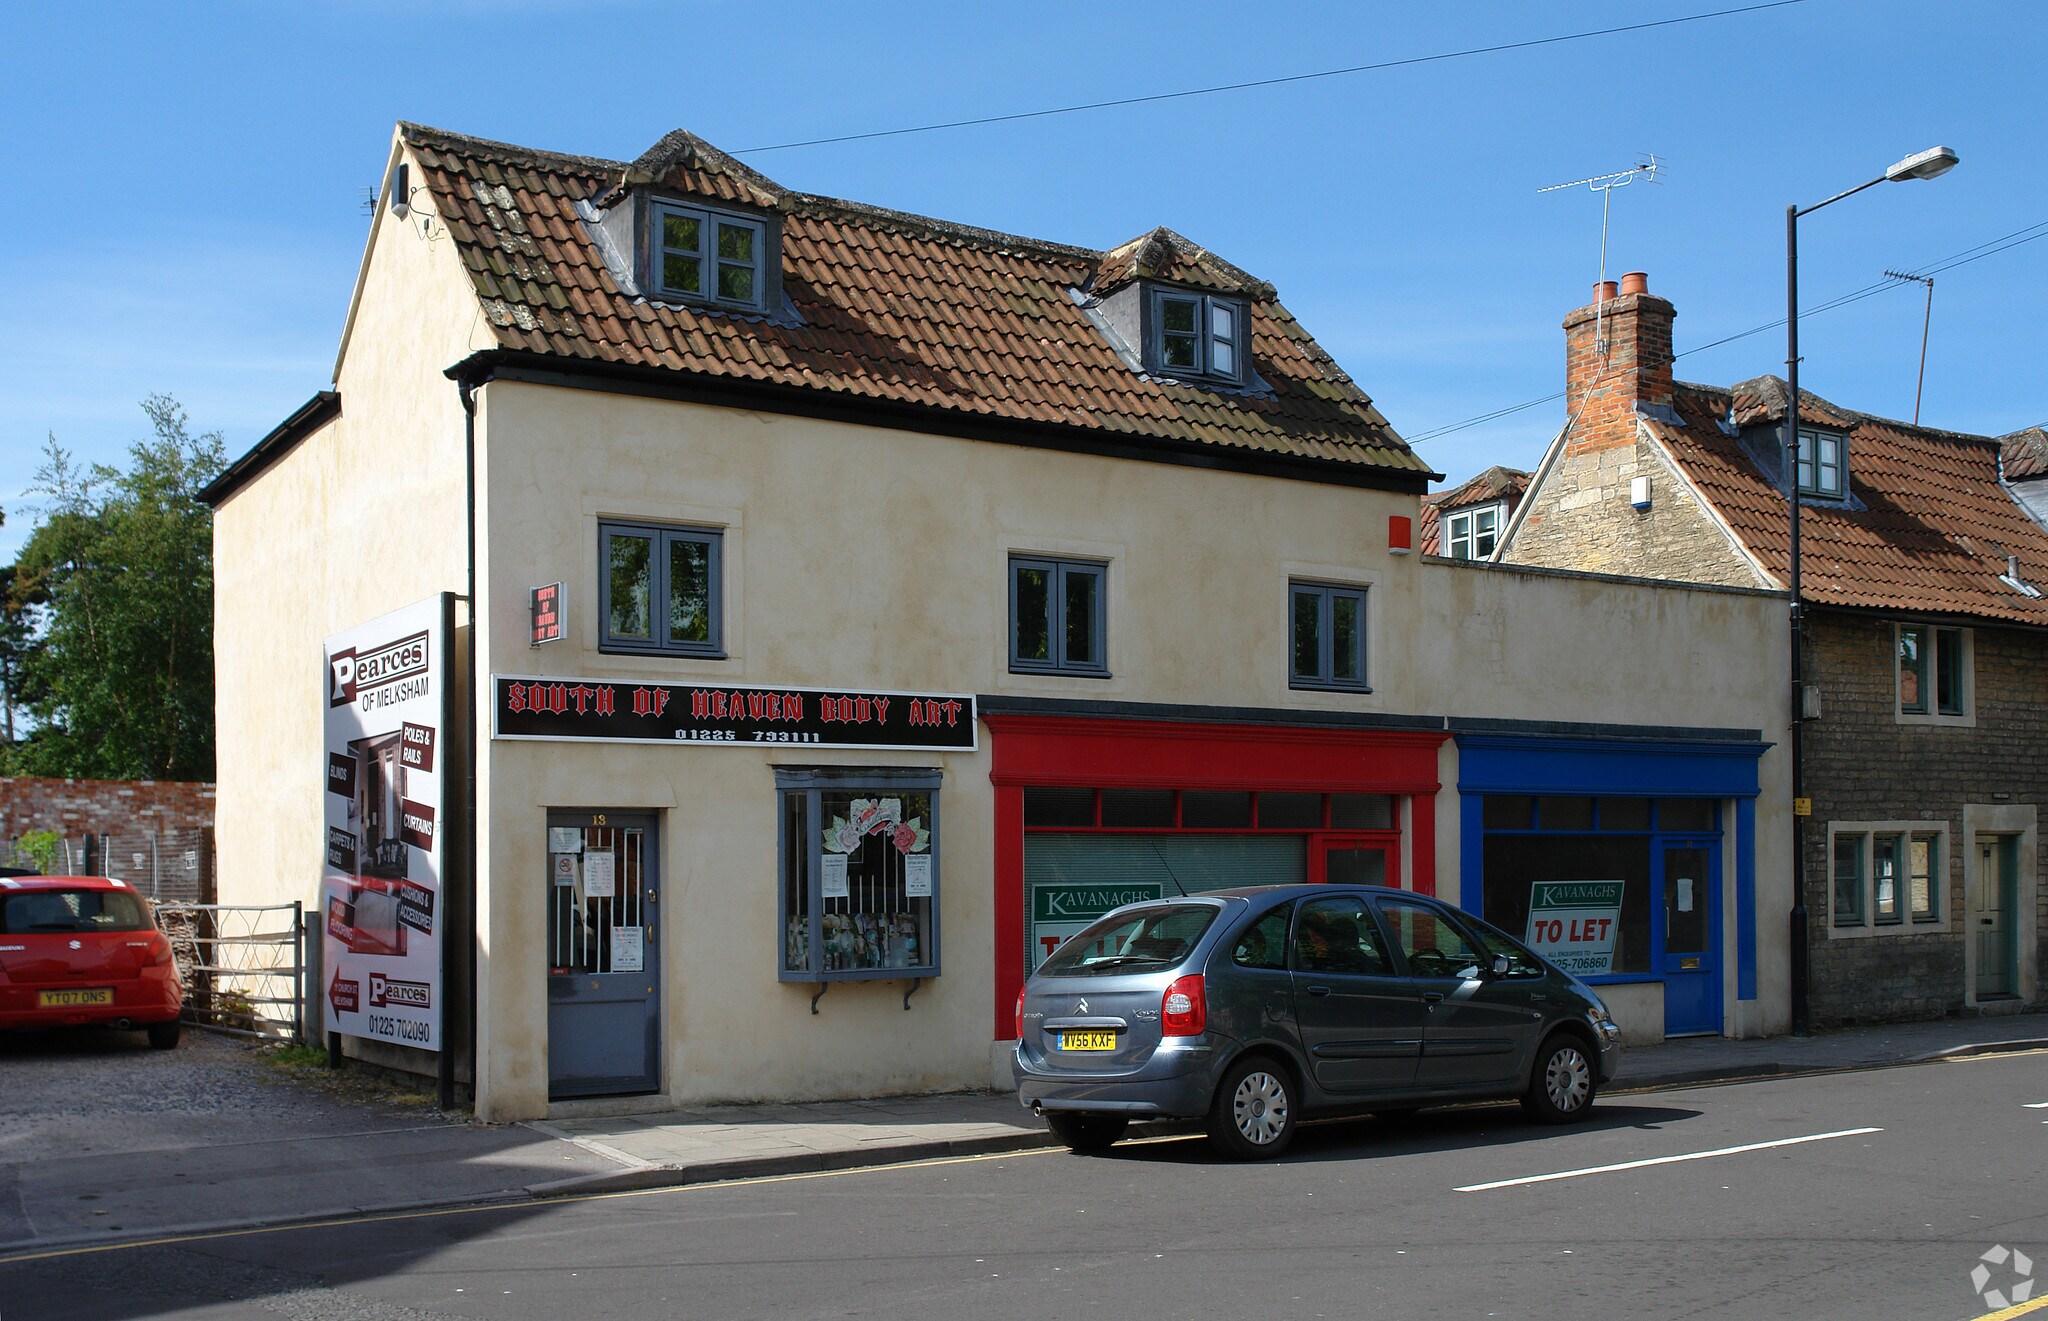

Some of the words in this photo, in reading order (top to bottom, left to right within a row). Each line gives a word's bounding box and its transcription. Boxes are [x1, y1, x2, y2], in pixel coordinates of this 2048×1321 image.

[331, 643, 422, 700] Pearces
[362, 692, 375, 712] OF
[376, 676, 428, 709] MELKSHAM
[508, 681, 616, 717] SOUTH
[632, 686, 671, 718] OF
[691, 688, 804, 723] HEAVEN
[820, 694, 891, 726] BODY
[909, 698, 962, 728] ART
[403, 726, 425, 744] POLES
[424, 730, 431, 745] &
[675, 728, 736, 741] 01225
[402, 746, 422, 765] RAILS
[330, 764, 348, 781] BLINDS
[403, 813, 433, 836] CURTAINS
[592, 814, 607, 826] 13
[329, 830, 351, 850] CARPETS
[329, 848, 342, 865] RUGS
[401, 883, 425, 906] CUSHIONS
[1045, 890, 1151, 916] KAVANAGHS
[1541, 885, 1616, 906] KAVANAGHS
[330, 899, 346, 917] WOOD
[400, 903, 432, 931] ACCESSORIES
[330, 918, 353, 941] FLOORING
[1535, 919, 1563, 944] TO
[1569, 918, 1612, 942] LET
[1551, 957, 1608, 970] 25-706860
[46, 992, 78, 1004] YT07
[81, 991, 106, 1003] ONS
[370, 977, 427, 1003] Pearces
[369, 1014, 395, 1037] 01225
[396, 1018, 430, 1043] 702090
[1064, 1032, 1089, 1048] WV56
[1091, 1032, 1114, 1047] KXF
